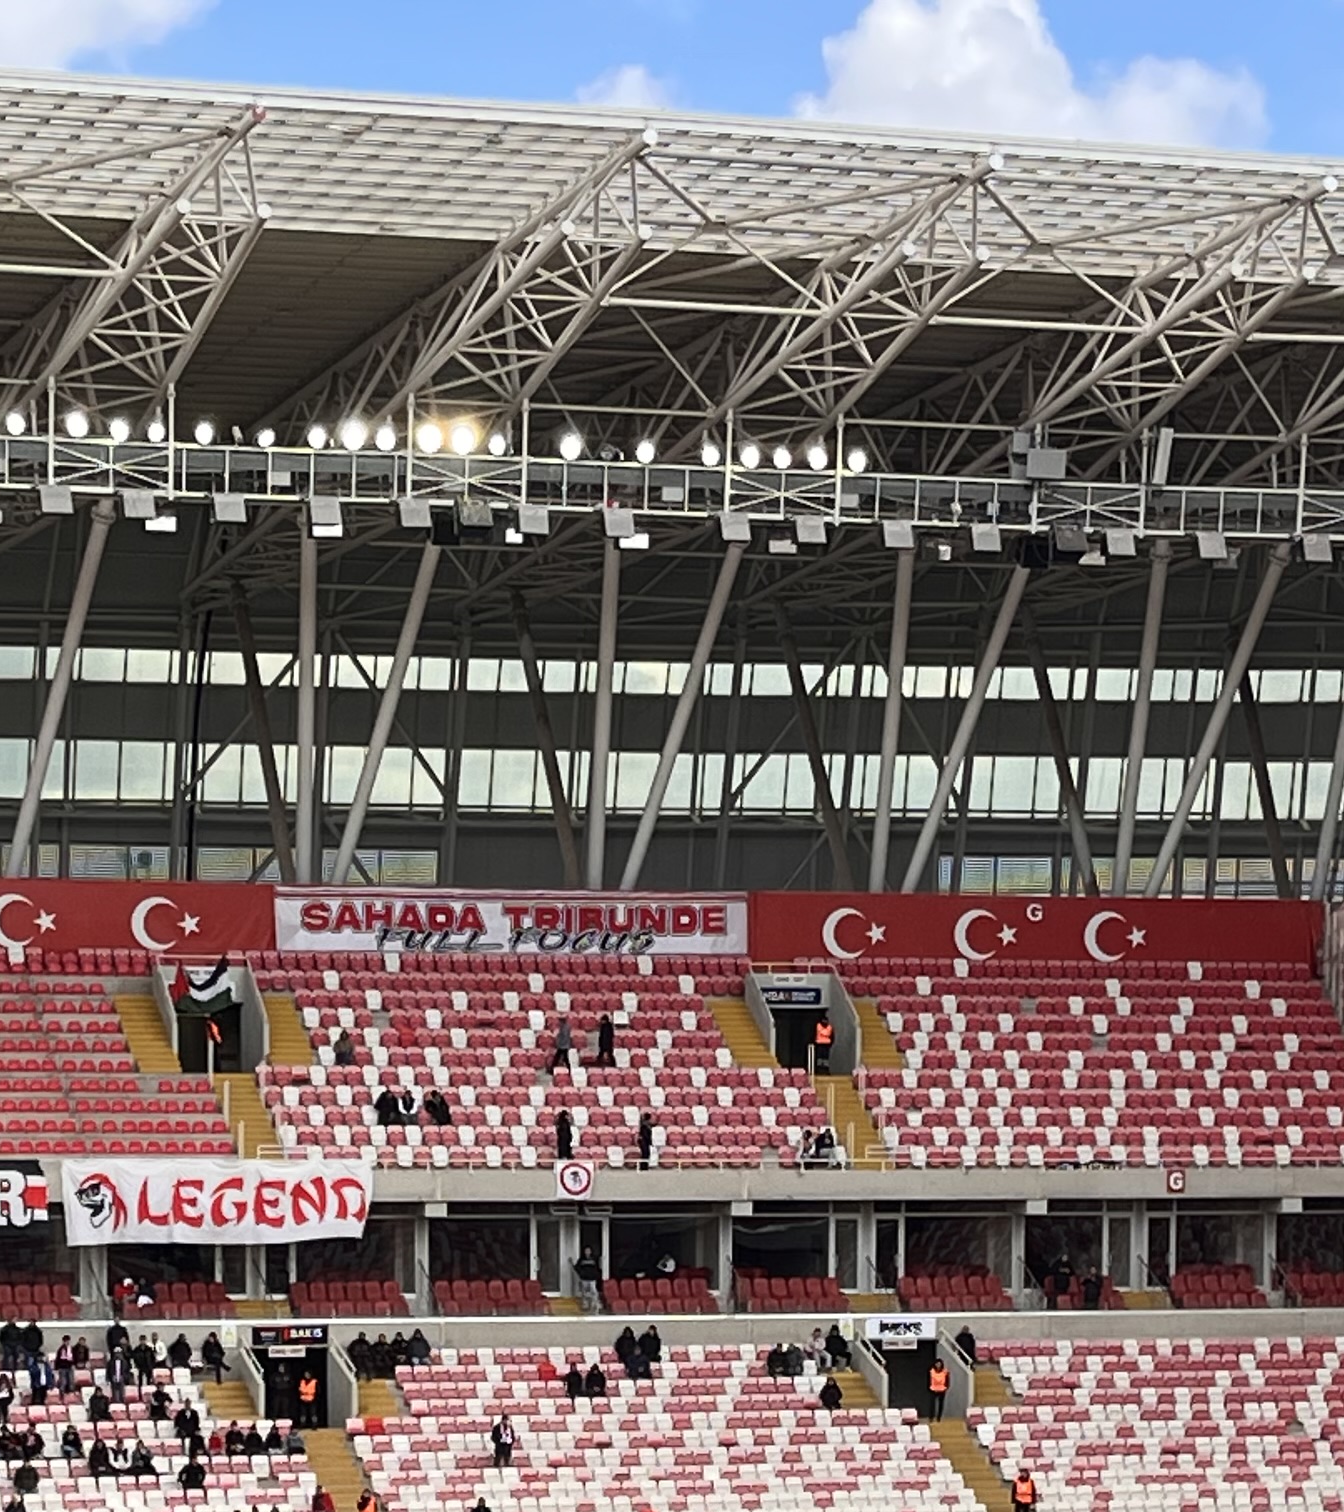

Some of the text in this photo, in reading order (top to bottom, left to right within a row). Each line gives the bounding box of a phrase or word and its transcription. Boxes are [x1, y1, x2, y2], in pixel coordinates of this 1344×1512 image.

[299, 900, 488, 934] SAHADA
[1026, 903, 1044, 922] G
[1168, 1171, 1185, 1191] G
[136, 1176, 369, 1230] LEGEND
